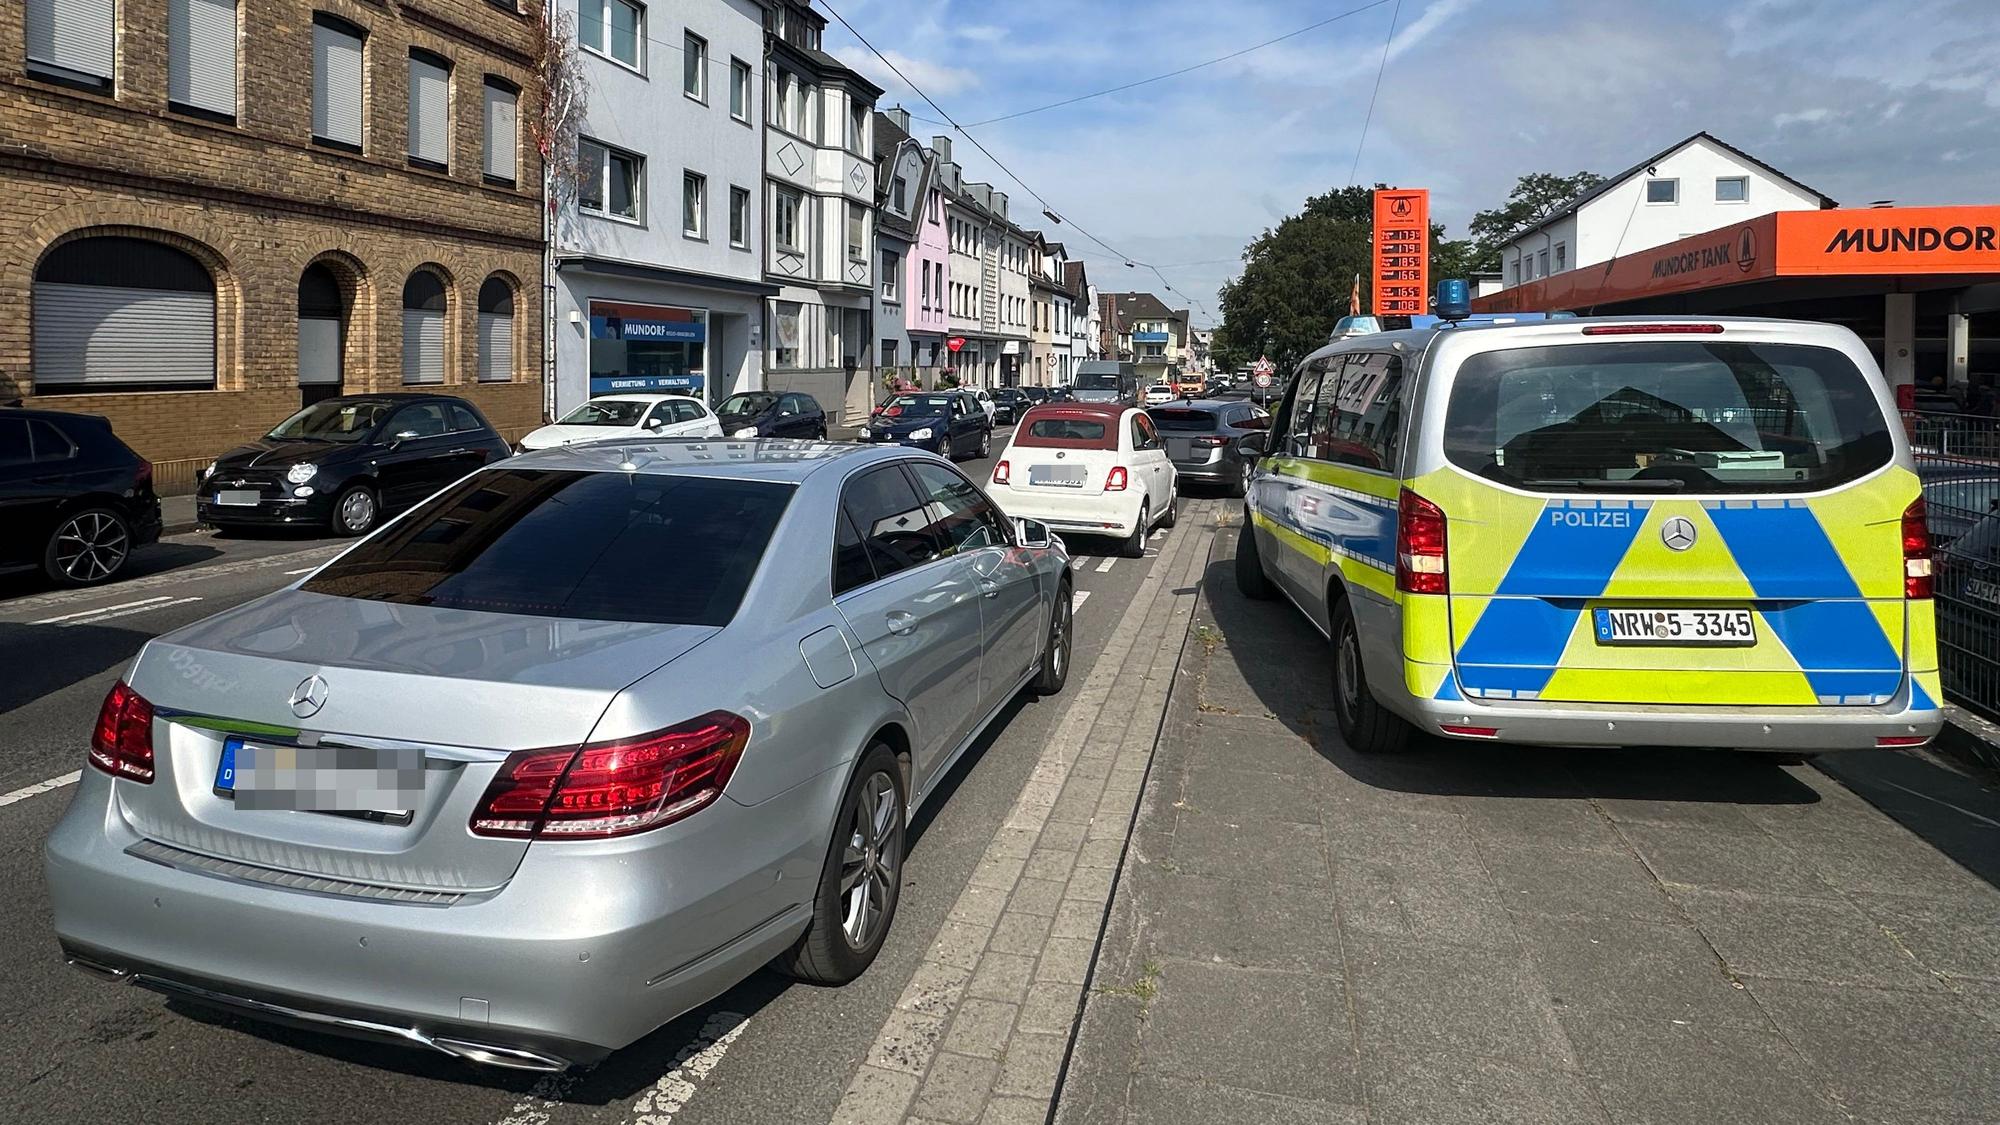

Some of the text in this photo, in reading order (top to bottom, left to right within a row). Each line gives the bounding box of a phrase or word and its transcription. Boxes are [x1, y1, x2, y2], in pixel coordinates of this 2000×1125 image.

[1824, 226, 2000, 253] MUNDOR
[1652, 244, 1730, 278] MUNDORF TANK
[624, 323, 666, 336] MUNDORF
[611, 378, 690, 388] VERMIETUNG VERWALTUNG
[1551, 511, 1630, 528] POLIZEI
[1601, 627, 1609, 635] D
[1612, 613, 1751, 636] NRW 5-3345
[224, 768, 232, 780] D
